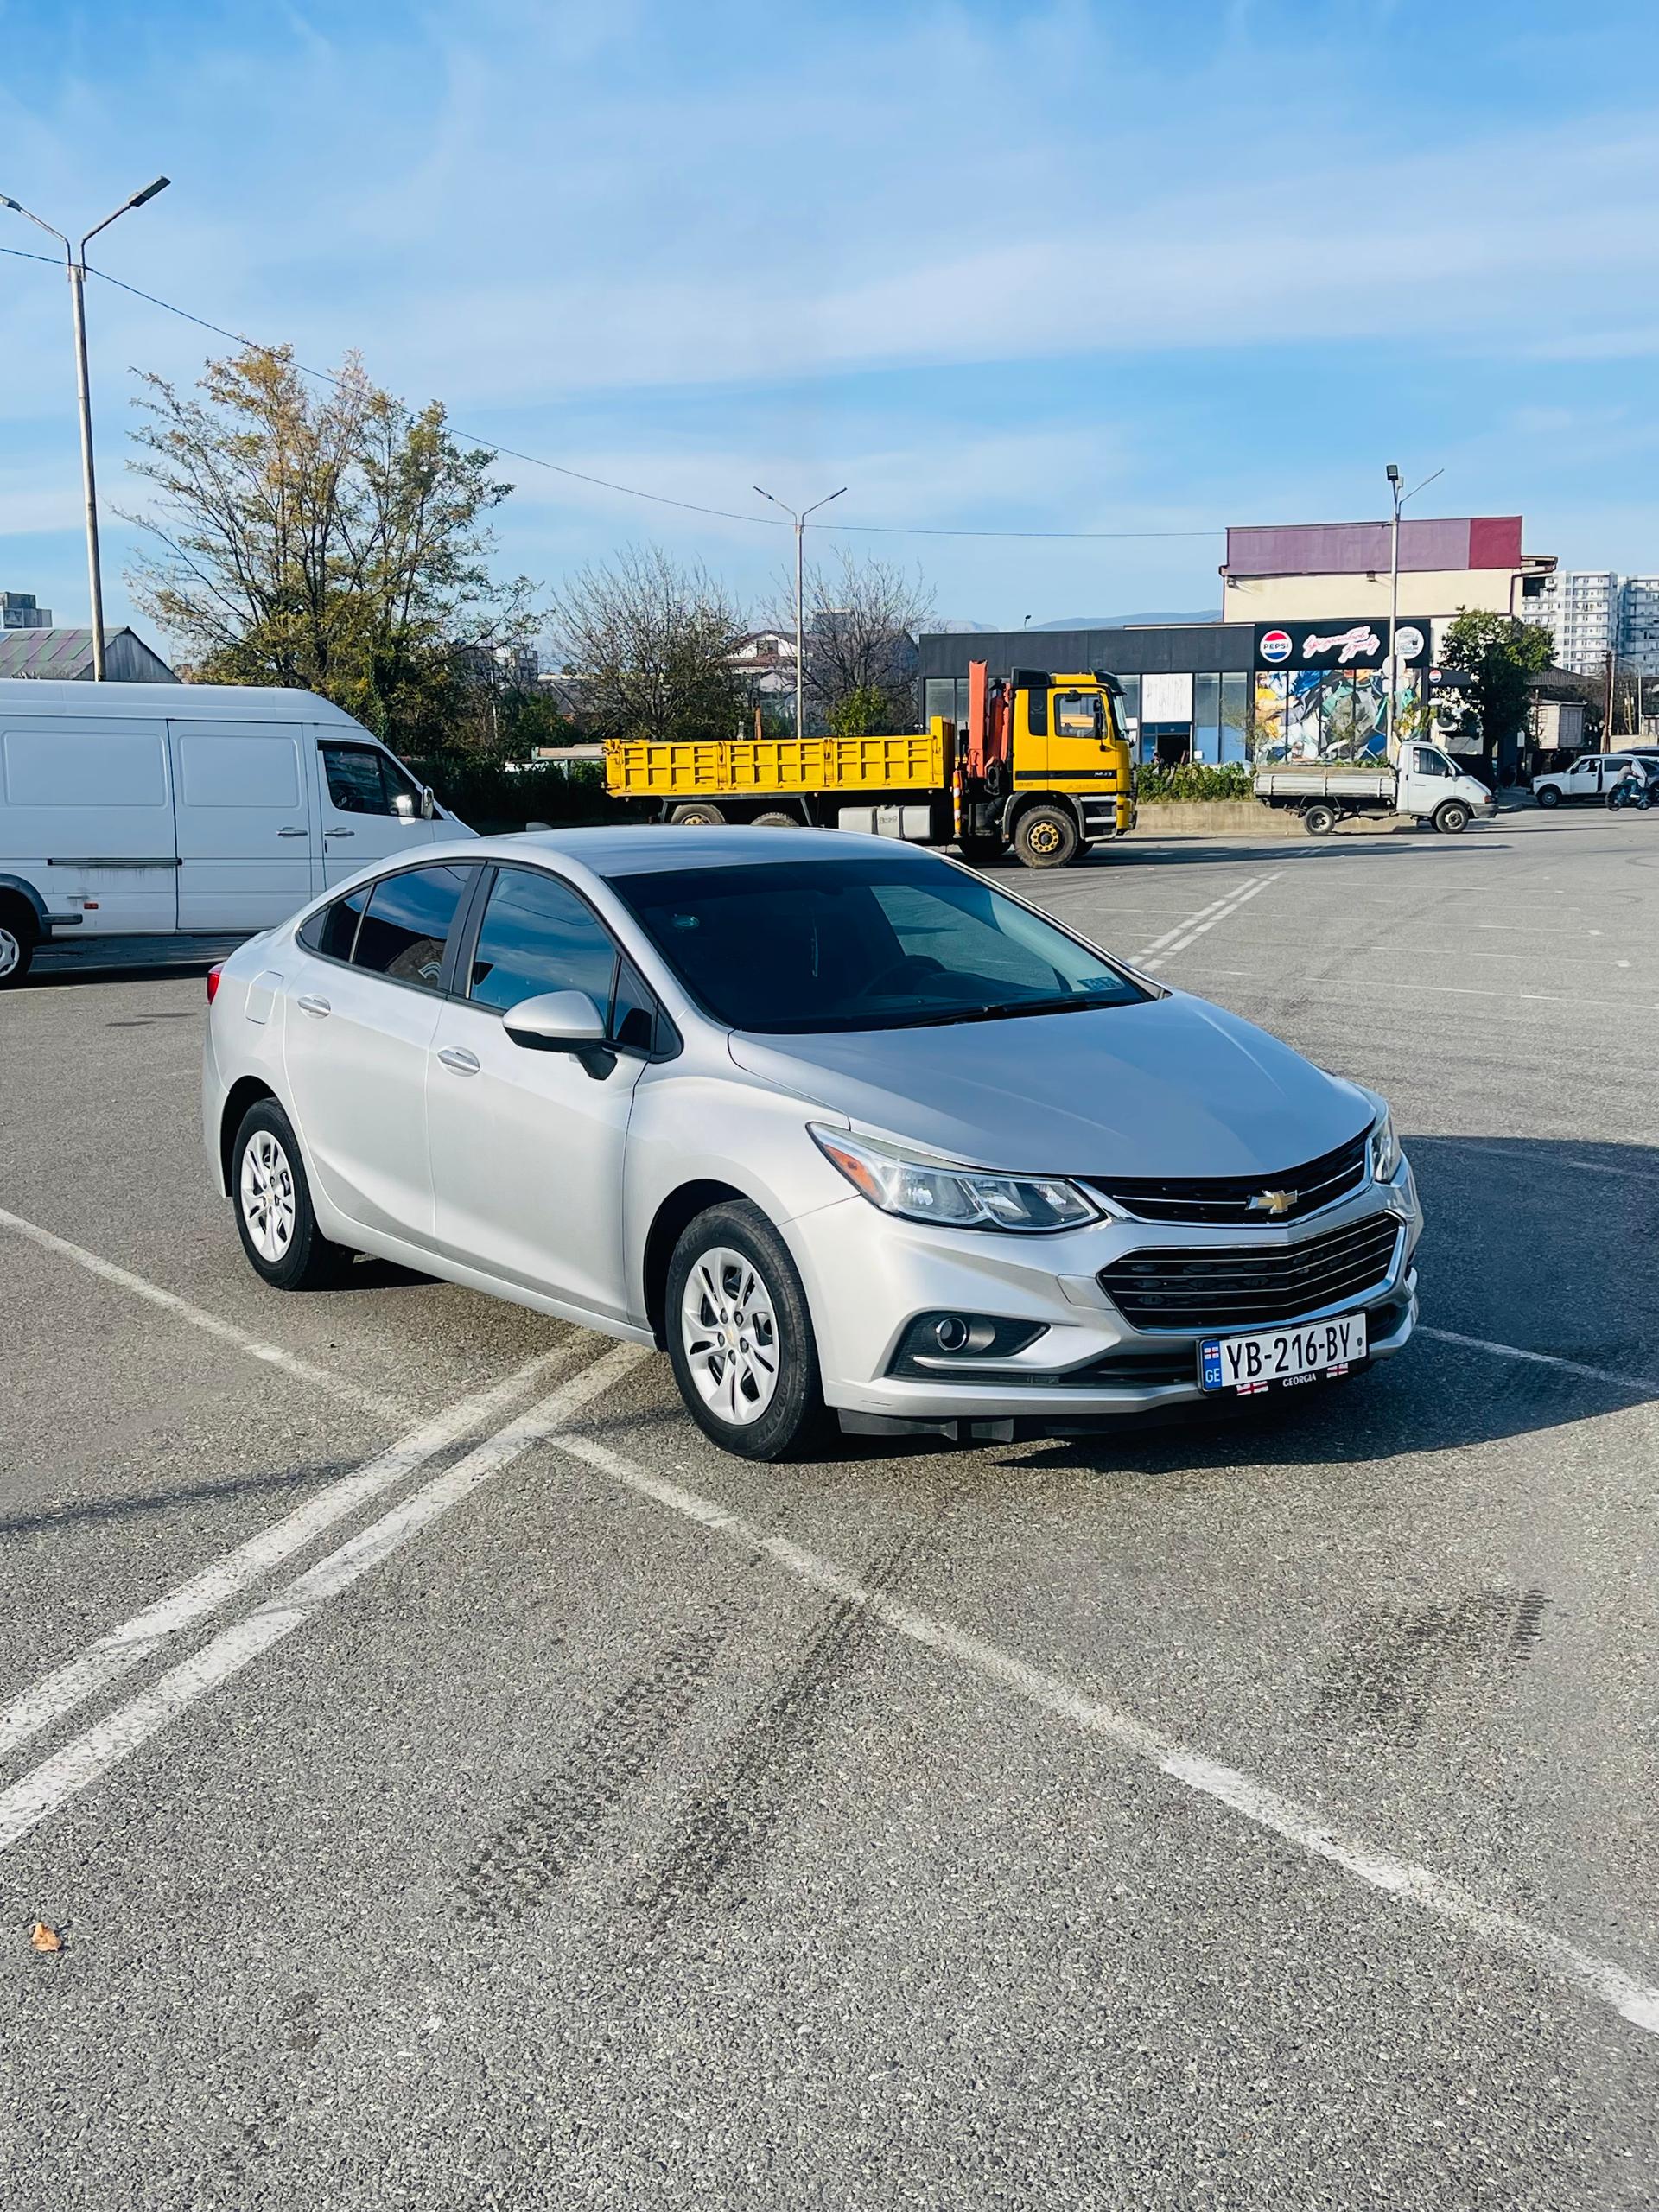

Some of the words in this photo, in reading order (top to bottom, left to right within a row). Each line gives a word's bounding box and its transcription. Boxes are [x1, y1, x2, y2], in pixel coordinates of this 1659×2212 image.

[1226, 1322, 1351, 1380] YB-216-BY
[1205, 1368, 1221, 1383] GE
[1282, 1373, 1317, 1388] GEORGIA
